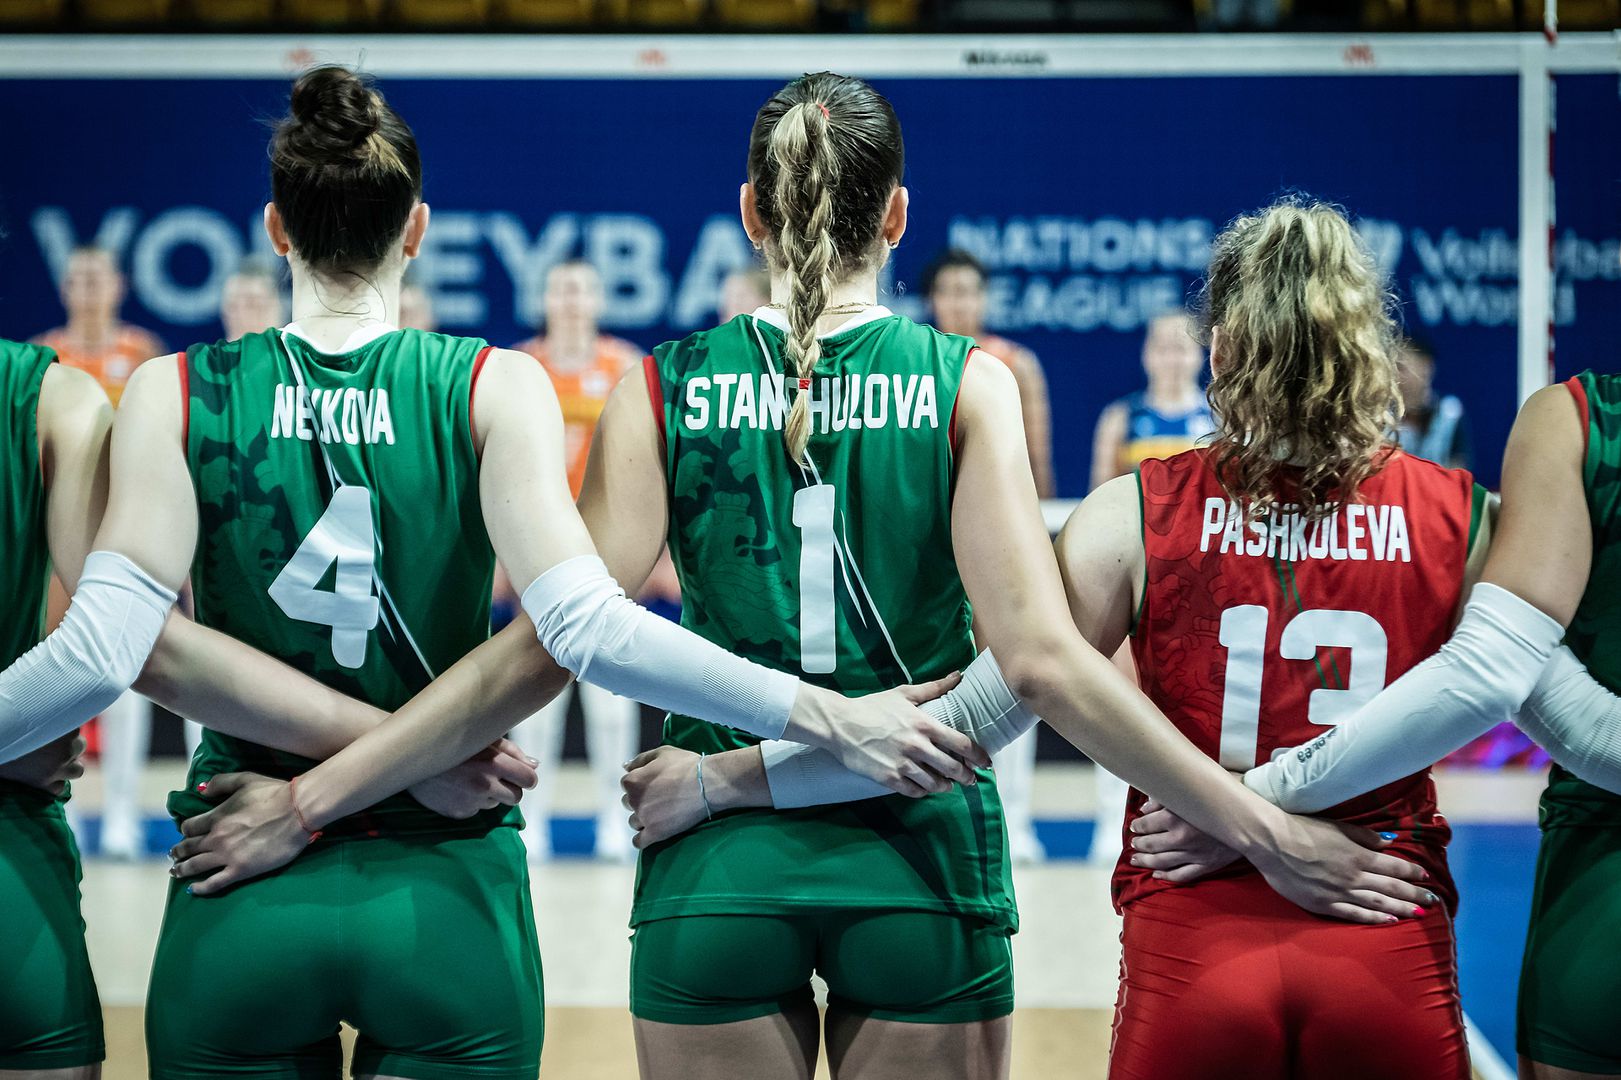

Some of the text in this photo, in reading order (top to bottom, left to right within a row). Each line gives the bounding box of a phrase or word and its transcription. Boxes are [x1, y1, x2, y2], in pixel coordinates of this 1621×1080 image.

[949, 216, 1212, 272] NATIONS
[978, 275, 1178, 332] EAGUE
[684, 373, 939, 434] STANHULOVA
[1200, 497, 1412, 562] PASHKULEVA
[267, 485, 380, 669] 4
[792, 484, 837, 674] 1
[1218, 604, 1388, 772] 13
